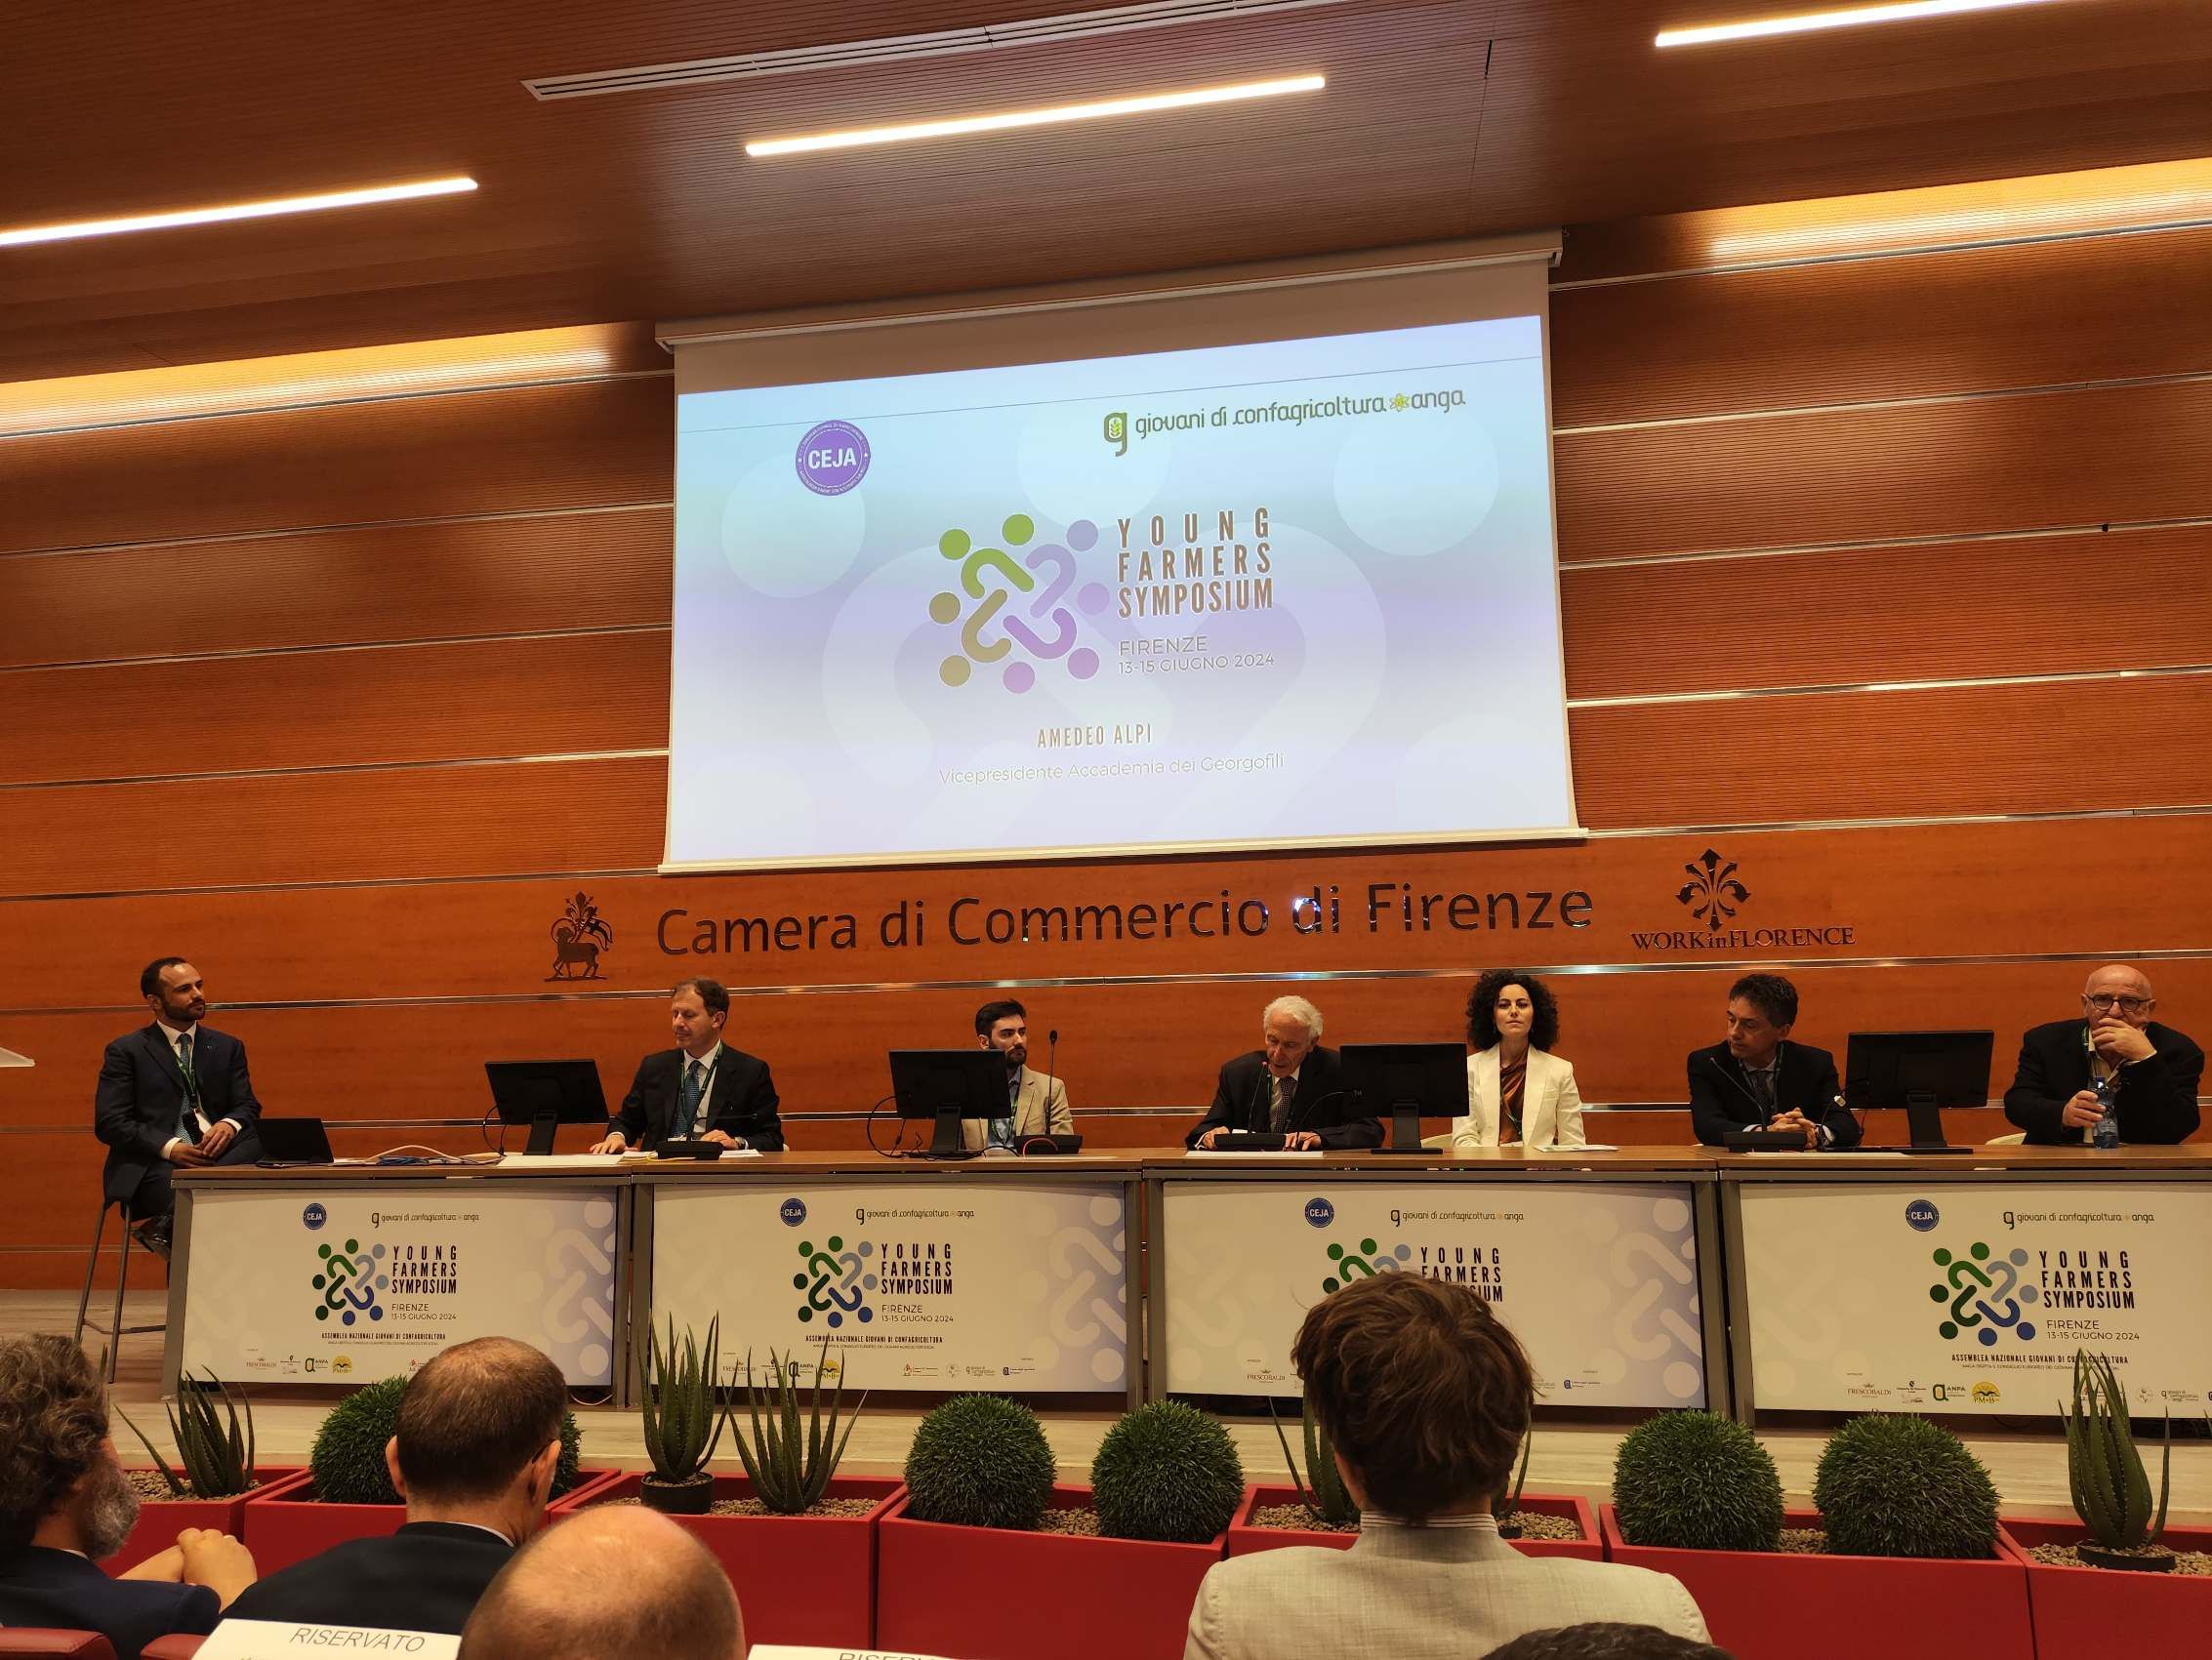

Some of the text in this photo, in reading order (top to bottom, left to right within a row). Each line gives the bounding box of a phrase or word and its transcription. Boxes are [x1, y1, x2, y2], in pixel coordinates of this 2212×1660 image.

[1135, 408, 1205, 439] giovani
[1211, 406, 1227, 426] di
[1233, 396, 1387, 426] confagricoltura
[1412, 390, 1465, 414] anga
[807, 447, 856, 469] CEJA
[1118, 507, 1270, 548] YOUNG
[1118, 543, 1271, 583] FARMERS
[1118, 578, 1273, 619] SYMPOSIUM
[1120, 635, 1208, 657] FIRENZE
[1119, 652, 1275, 674] 13-15 GIUGNO 2024
[1037, 722, 1152, 749] AMEDEO ALPI
[939, 752, 1285, 785] Vicepresidente Accademia dei Georgofili
[657, 882, 1593, 954] Camera di Commercio di Firenze
[307, 1212, 322, 1221] CEJA
[784, 1208, 802, 1217] CEJA
[866, 1209, 890, 1220] giovani
[892, 1209, 898, 1219] di
[899, 1209, 950, 1220] confagricoltura
[958, 1210, 975, 1220] anga
[1309, 1208, 1330, 1217] CEJA
[1403, 1210, 1429, 1220] giovani
[1431, 1210, 1438, 1219] di
[1439, 1210, 1495, 1221] confagricoltura
[1504, 1212, 1524, 1223] anga
[1910, 1211, 1934, 1221] CEJA
[2017, 1212, 2047, 1224] giovani
[2048, 1212, 2057, 1222] di
[2059, 1212, 2122, 1225] confagricoltura
[2131, 1214, 2154, 1225] anga
[393, 1245, 457, 1260] YOUNG
[881, 1243, 952, 1259] YOUNG
[1421, 1246, 1499, 1264] YOUNG
[881, 1261, 952, 1276] FARMERS
[2039, 1251, 2129, 1269] YOUNG
[392, 1262, 457, 1276] FARMERS
[1421, 1266, 1501, 1283] FARMERS
[391, 1278, 457, 1294] SYMPOSIUM
[881, 1278, 953, 1295] SYMPOSIUM
[2041, 1271, 2132, 1288] FARMERS
[391, 1303, 430, 1312] FIRENZE
[2043, 1290, 2135, 1309] SYMPOSIUM
[881, 1304, 923, 1314] FIRENZE
[881, 1315, 954, 1323] 13-15 GIUGNO 2024
[2046, 1319, 2100, 1330] FIRENZE
[2047, 1331, 2140, 1341] 13-15 GIUGNO 2024
[1952, 1354, 1988, 1362] ASSEMBLEA
[1991, 1354, 2027, 1363] NAZIONALE
[2028, 1355, 2056, 1363] GIOVANI
[1847, 1388, 1892, 1397] FRESCOBALDI
[289, 1627, 426, 1652] RISERVATO
